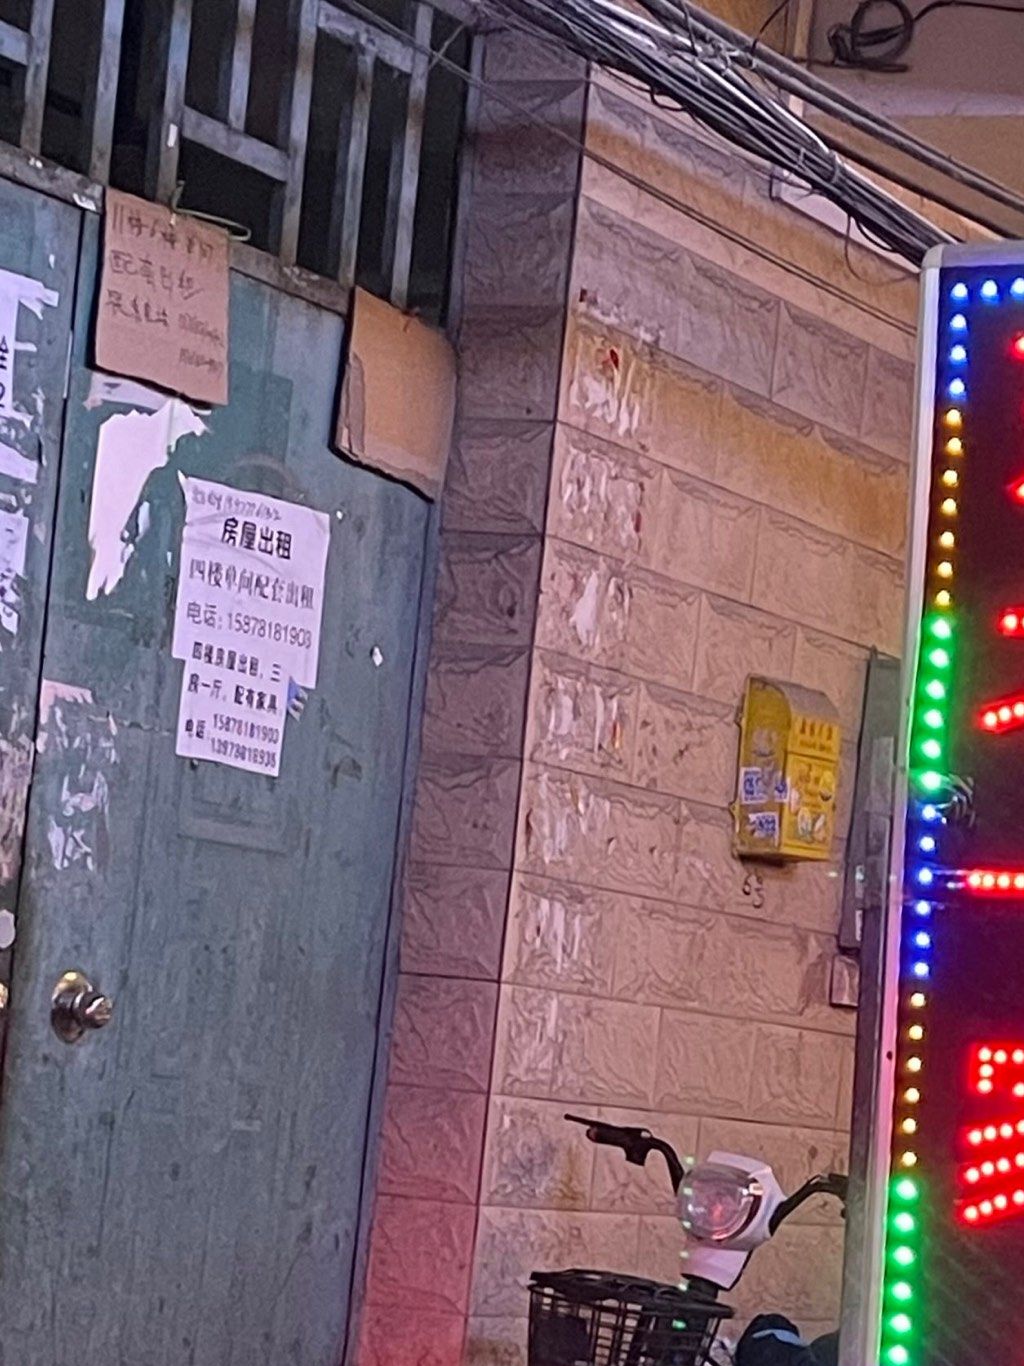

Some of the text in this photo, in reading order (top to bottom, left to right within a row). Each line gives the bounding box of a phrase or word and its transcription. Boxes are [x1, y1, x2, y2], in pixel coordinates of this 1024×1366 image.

[221, 517, 293, 561] 房屋出租
[189, 558, 315, 610] 四楼单间配套出租
